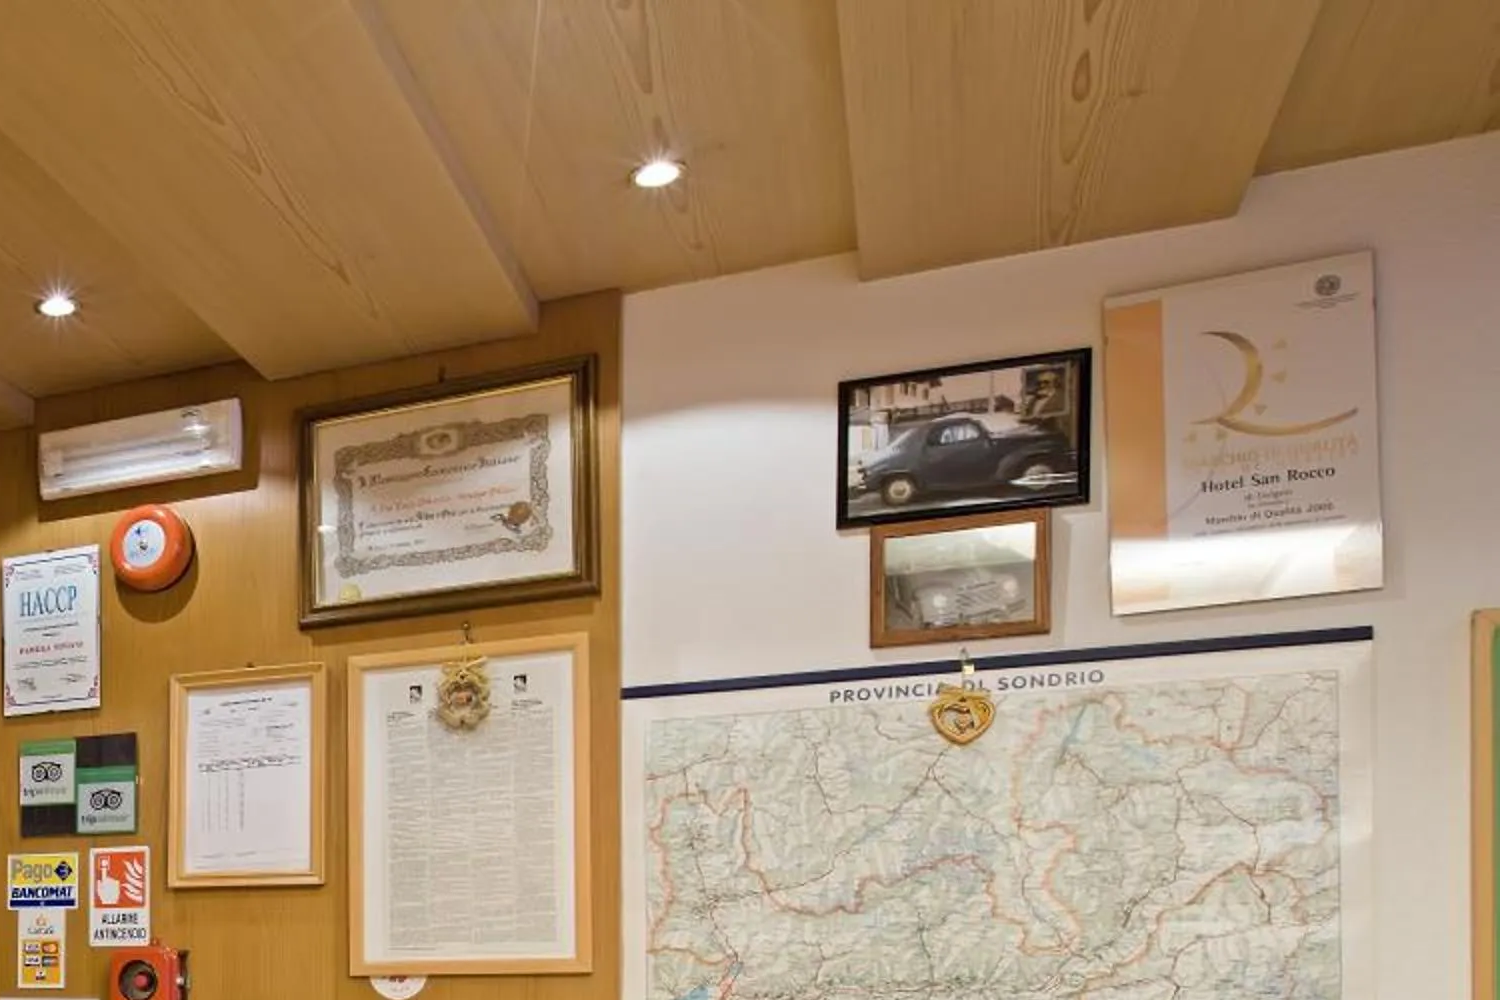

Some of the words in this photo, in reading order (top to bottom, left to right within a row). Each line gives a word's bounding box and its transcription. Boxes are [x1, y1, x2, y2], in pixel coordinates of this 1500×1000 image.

[1201, 475, 1244, 493] Hotel
[1251, 472, 1280, 487] San
[1287, 466, 1336, 482] Rocco
[19, 585, 77, 617] HACCP
[998, 670, 1105, 691] SONDRIO
[11, 858, 52, 884] Pago
[12, 886, 73, 899] BANCOMAT
[101, 912, 139, 925] ALLARME
[93, 928, 146, 940] ANTINCENDIO
